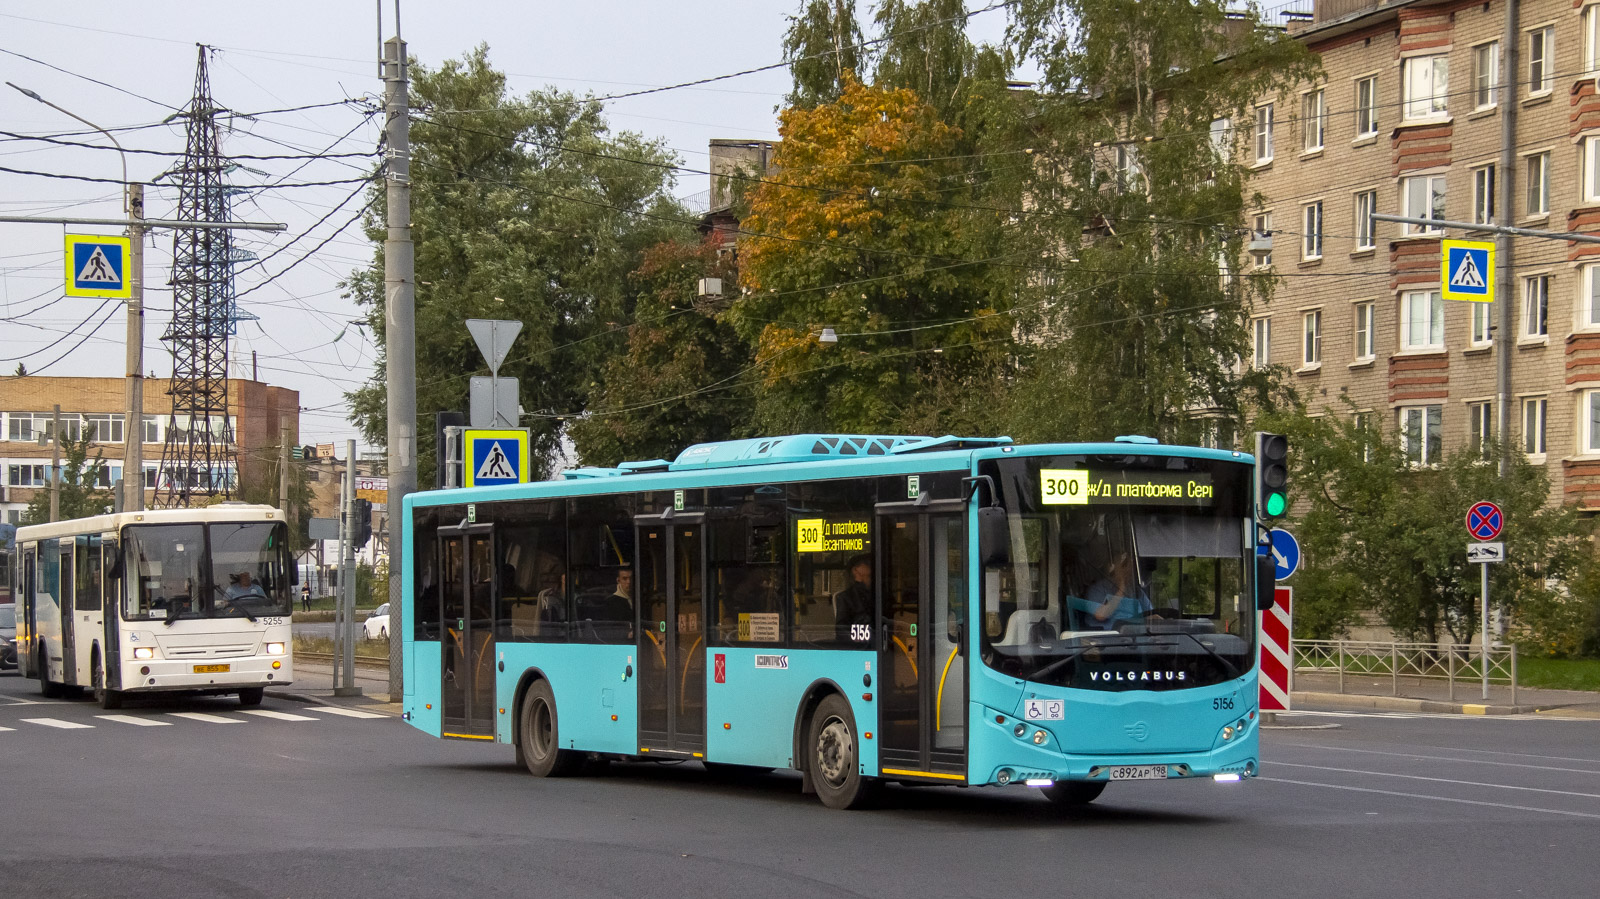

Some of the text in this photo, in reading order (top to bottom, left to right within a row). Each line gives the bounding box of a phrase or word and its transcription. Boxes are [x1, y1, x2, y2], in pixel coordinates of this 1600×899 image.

[1046, 479, 1078, 496] 300
[1088, 480, 1111, 497] ж/д
[1116, 482, 1182, 498] платформа
[832, 519, 868, 535] платформа
[801, 527, 818, 544] 300
[263, 617, 283, 626] 5255
[850, 624, 871, 641] 5156
[1089, 671, 1186, 681] VOLGABUS
[1212, 697, 1235, 710] 5156
[1152, 764, 1166, 774] 198
